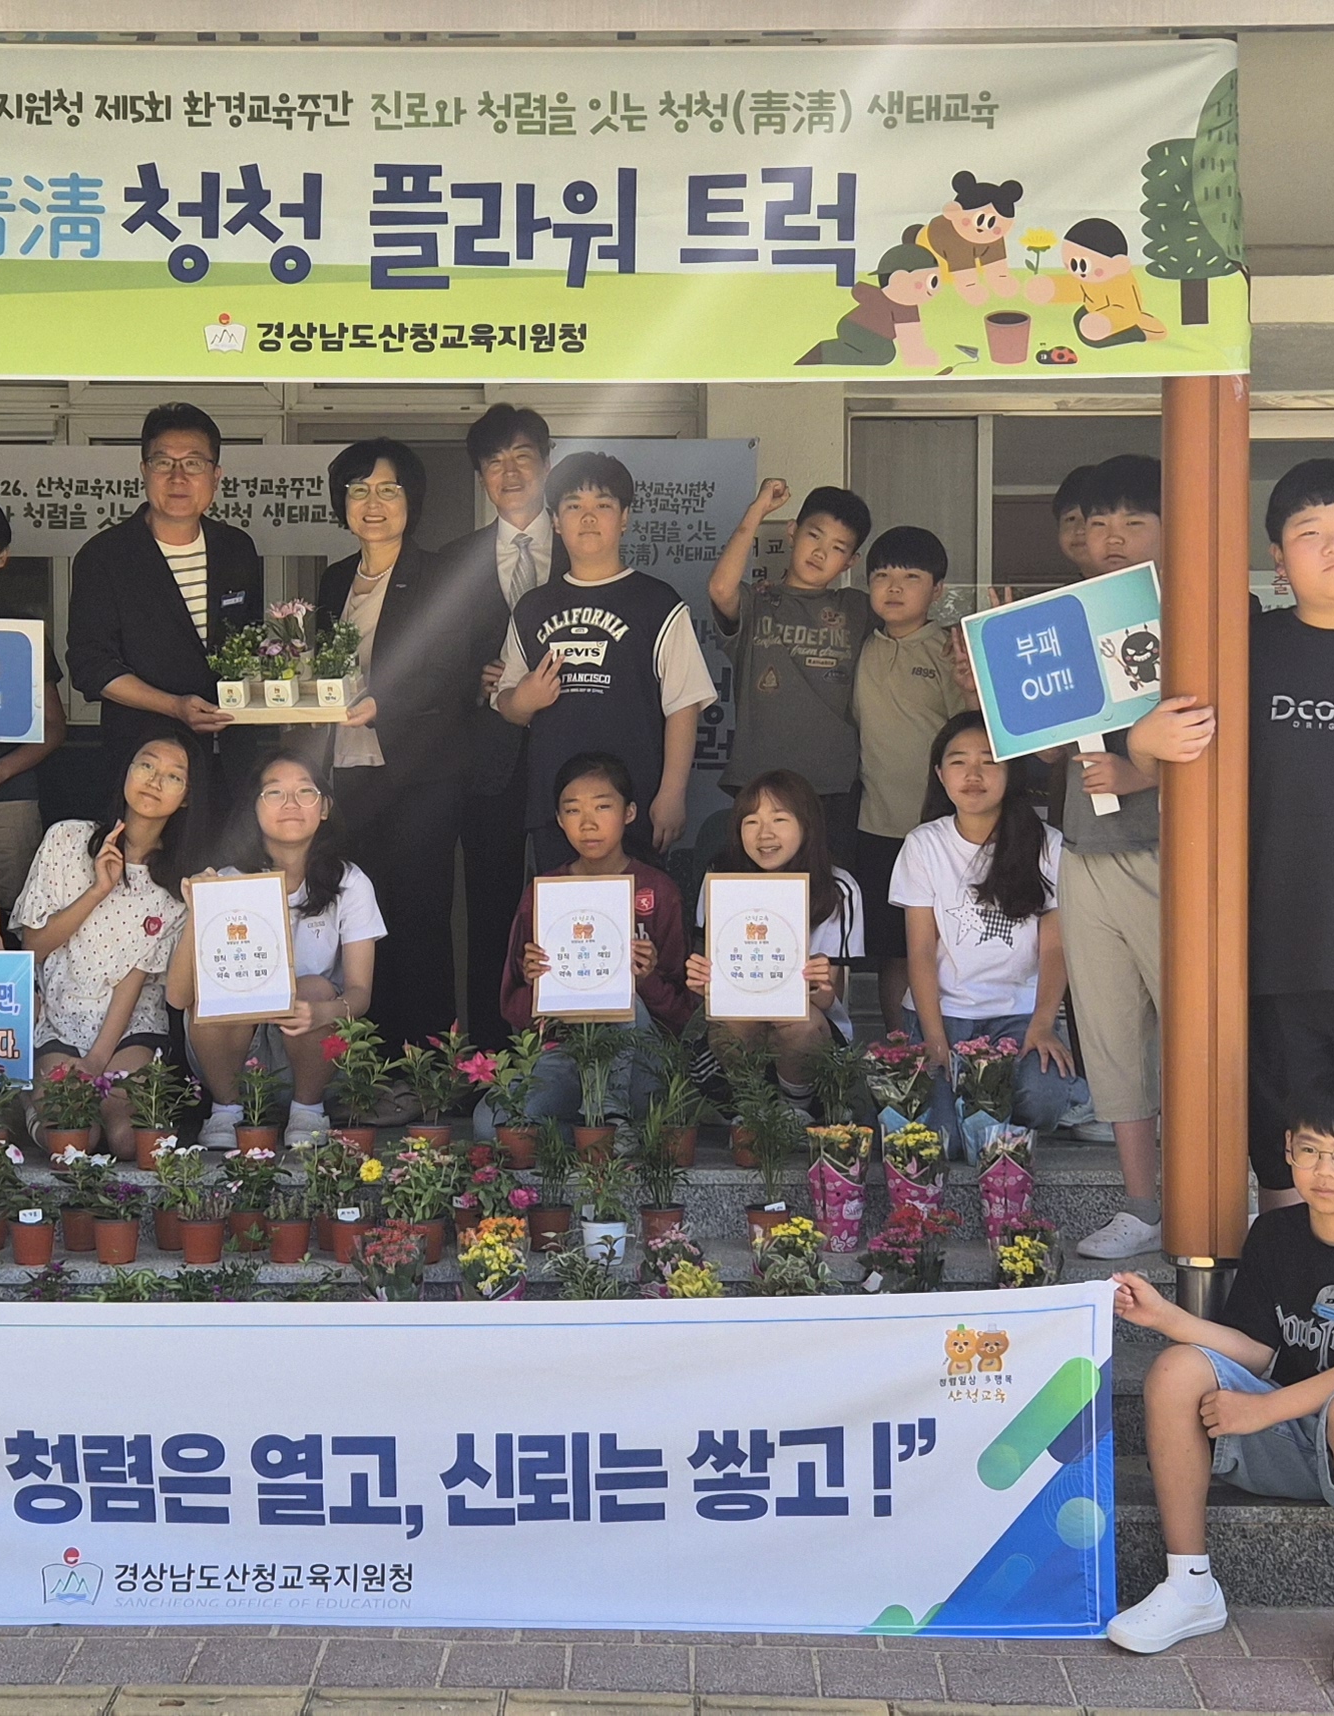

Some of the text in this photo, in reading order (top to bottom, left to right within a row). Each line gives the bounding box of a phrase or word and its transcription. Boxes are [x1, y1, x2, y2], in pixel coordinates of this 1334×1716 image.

[95, 91, 172, 124] 제5회
[184, 90, 354, 131] 환경교육주간
[371, 91, 467, 131] 진로와
[478, 91, 578, 135] 청렴을
[589, 97, 647, 134] 잇는
[867, 91, 1000, 131] 생태교육
[122, 161, 323, 284] 청청
[370, 163, 638, 290] 플라워
[679, 166, 857, 287] 트럭
[256, 319, 588, 354] 경상남도산청교육지원청
[221, 475, 324, 498] 환경교육주간
[23, 502, 87, 529] 청렴을
[632, 520, 716, 543] 청렴을 잇는
[536, 606, 630, 645] CALIFORNIA
[1015, 625, 1062, 666] 부패
[561, 672, 612, 684] FRANCISCO
[911, 666, 937, 680] 1895
[1021, 667, 1075, 700] OUT!!
[947, 1387, 1006, 1404] 산청교육
[5, 1430, 231, 1526] 청렴은
[250, 1433, 424, 1540] 열고,
[439, 1430, 669, 1525] 신뢰는
[114, 1562, 414, 1594] 경상남도산청교육지원청
[316, 1598, 412, 1611] EDUCATION
